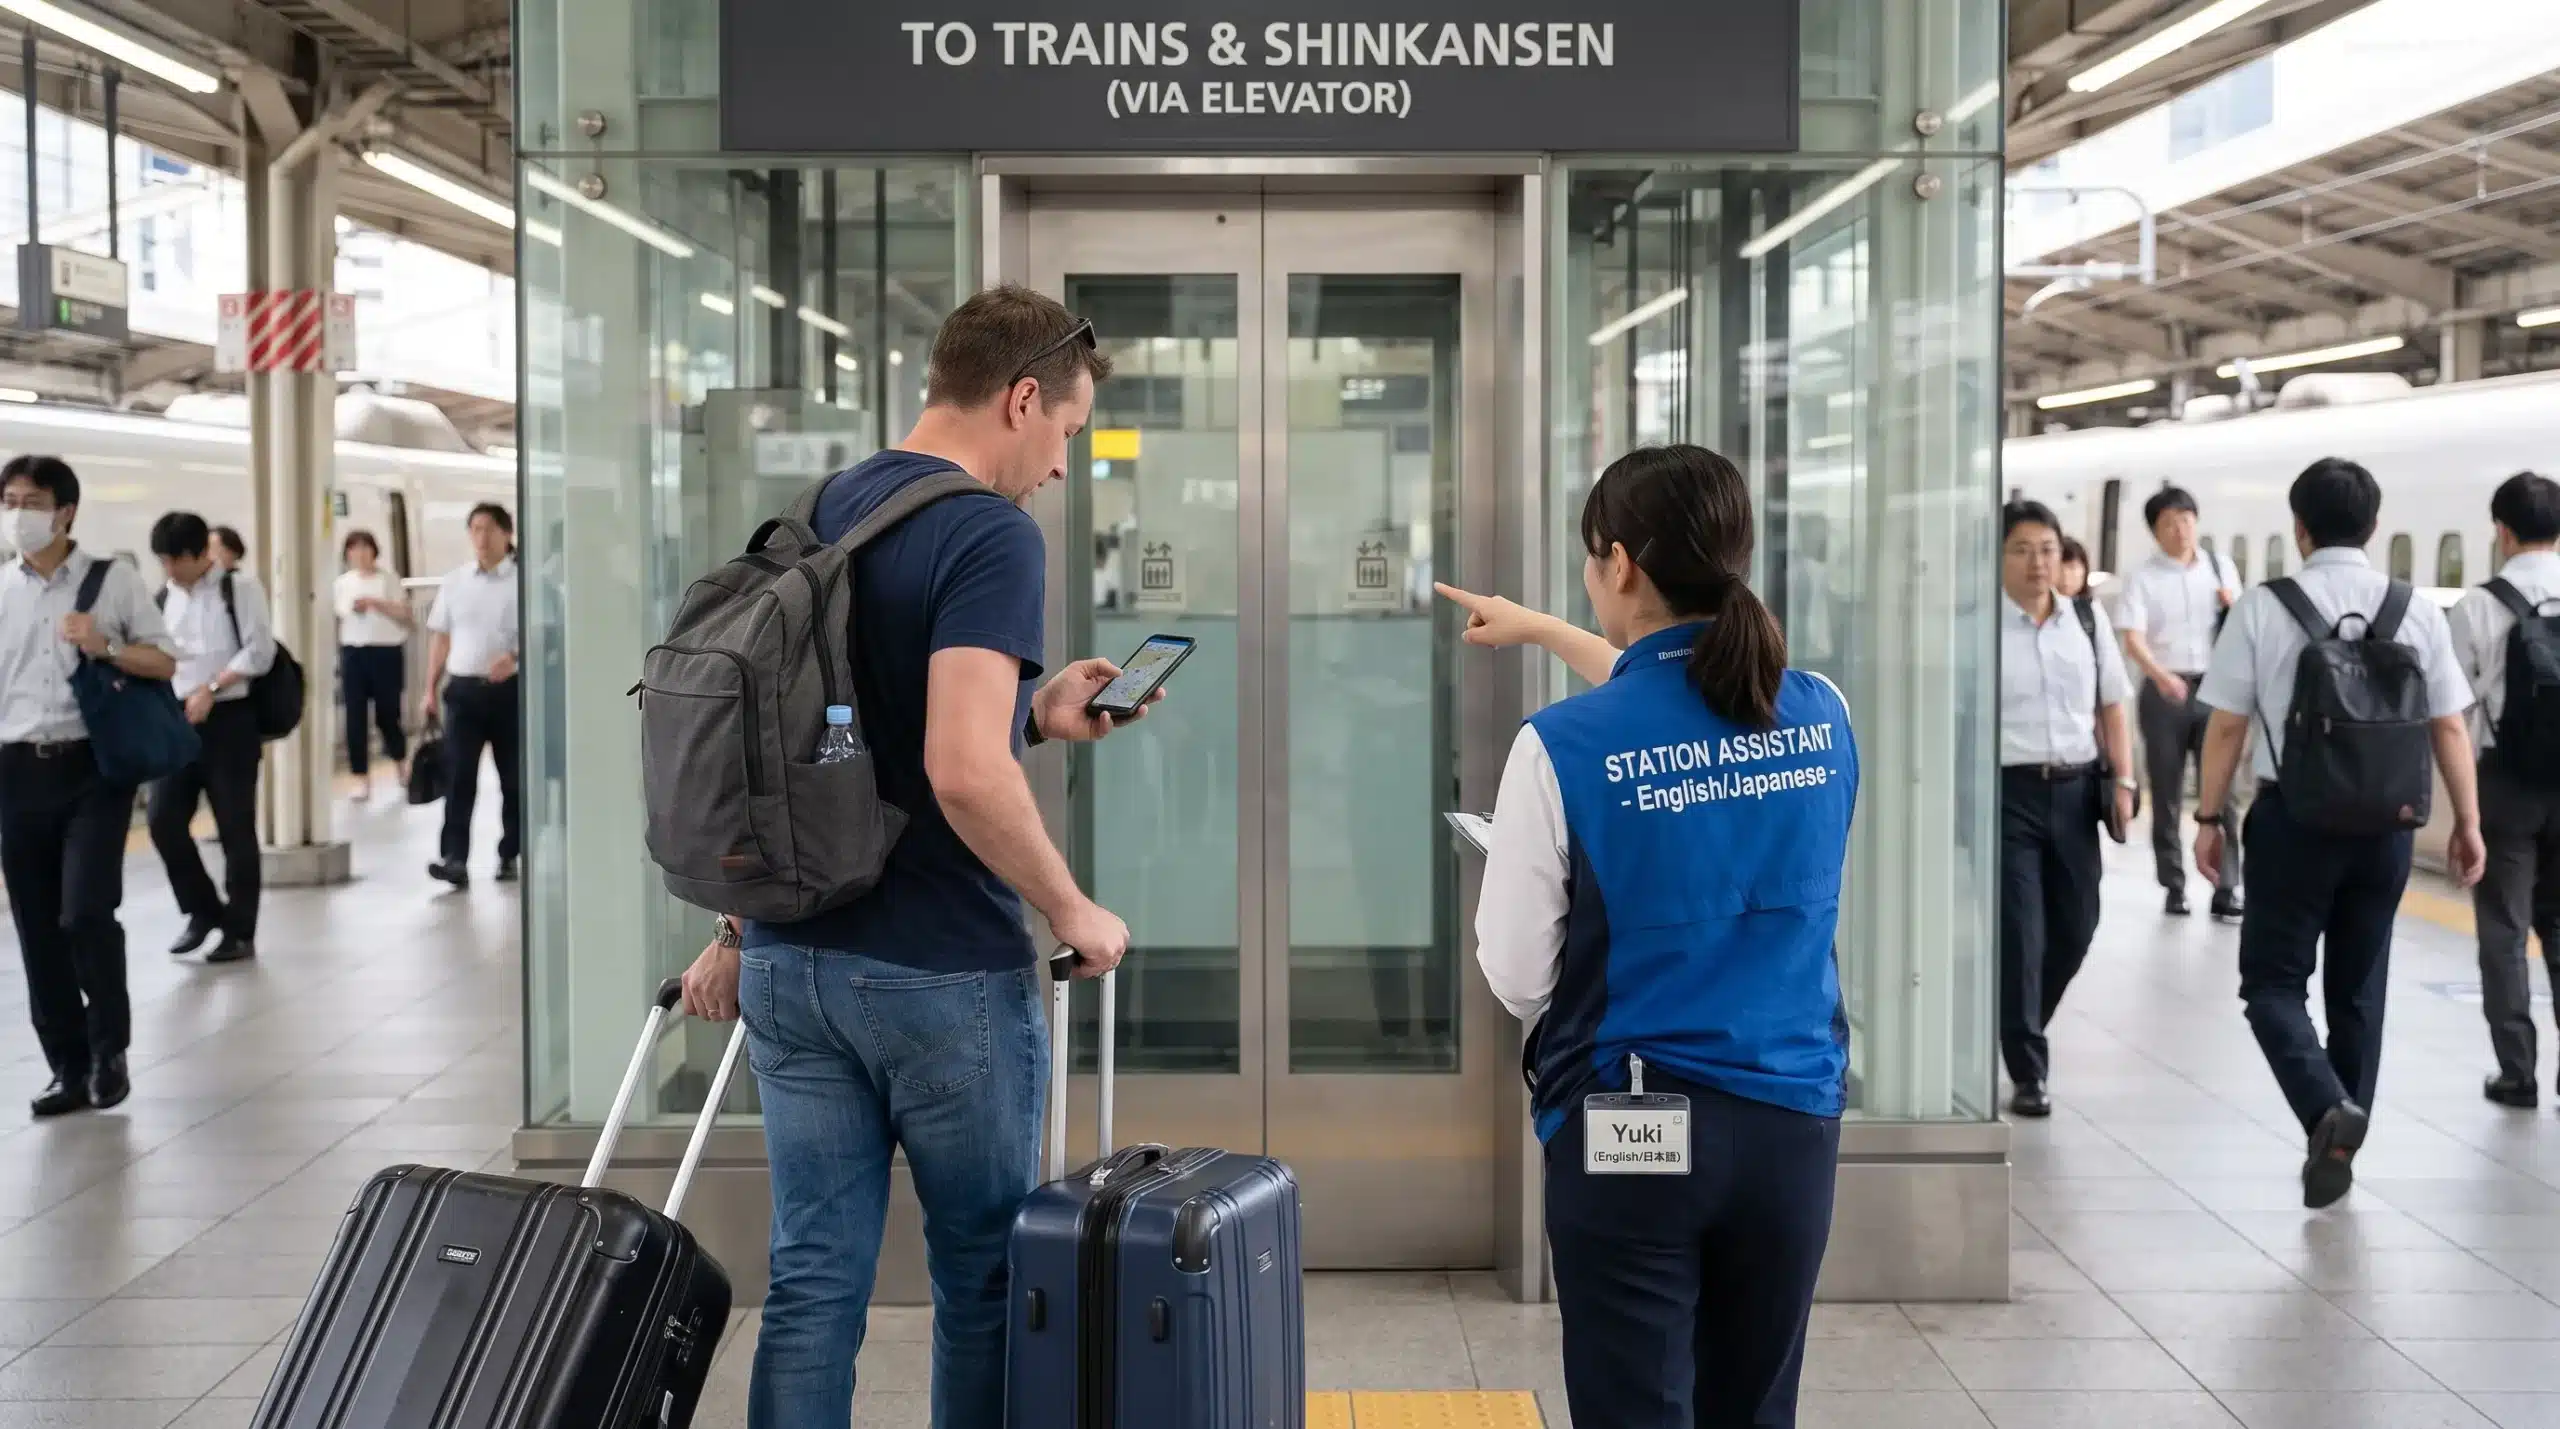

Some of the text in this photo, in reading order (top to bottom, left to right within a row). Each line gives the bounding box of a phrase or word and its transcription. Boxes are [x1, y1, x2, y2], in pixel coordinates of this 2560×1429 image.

[902, 22, 1614, 66] TO TRAINS & SHINKANSEN
[1107, 80, 1411, 118] (VIA ELEVATOR)
[1605, 723, 1833, 783] STATION ASSISTANT
[1636, 765, 1827, 813] English/Japanese
[1612, 1123, 1662, 1143] Yuki
